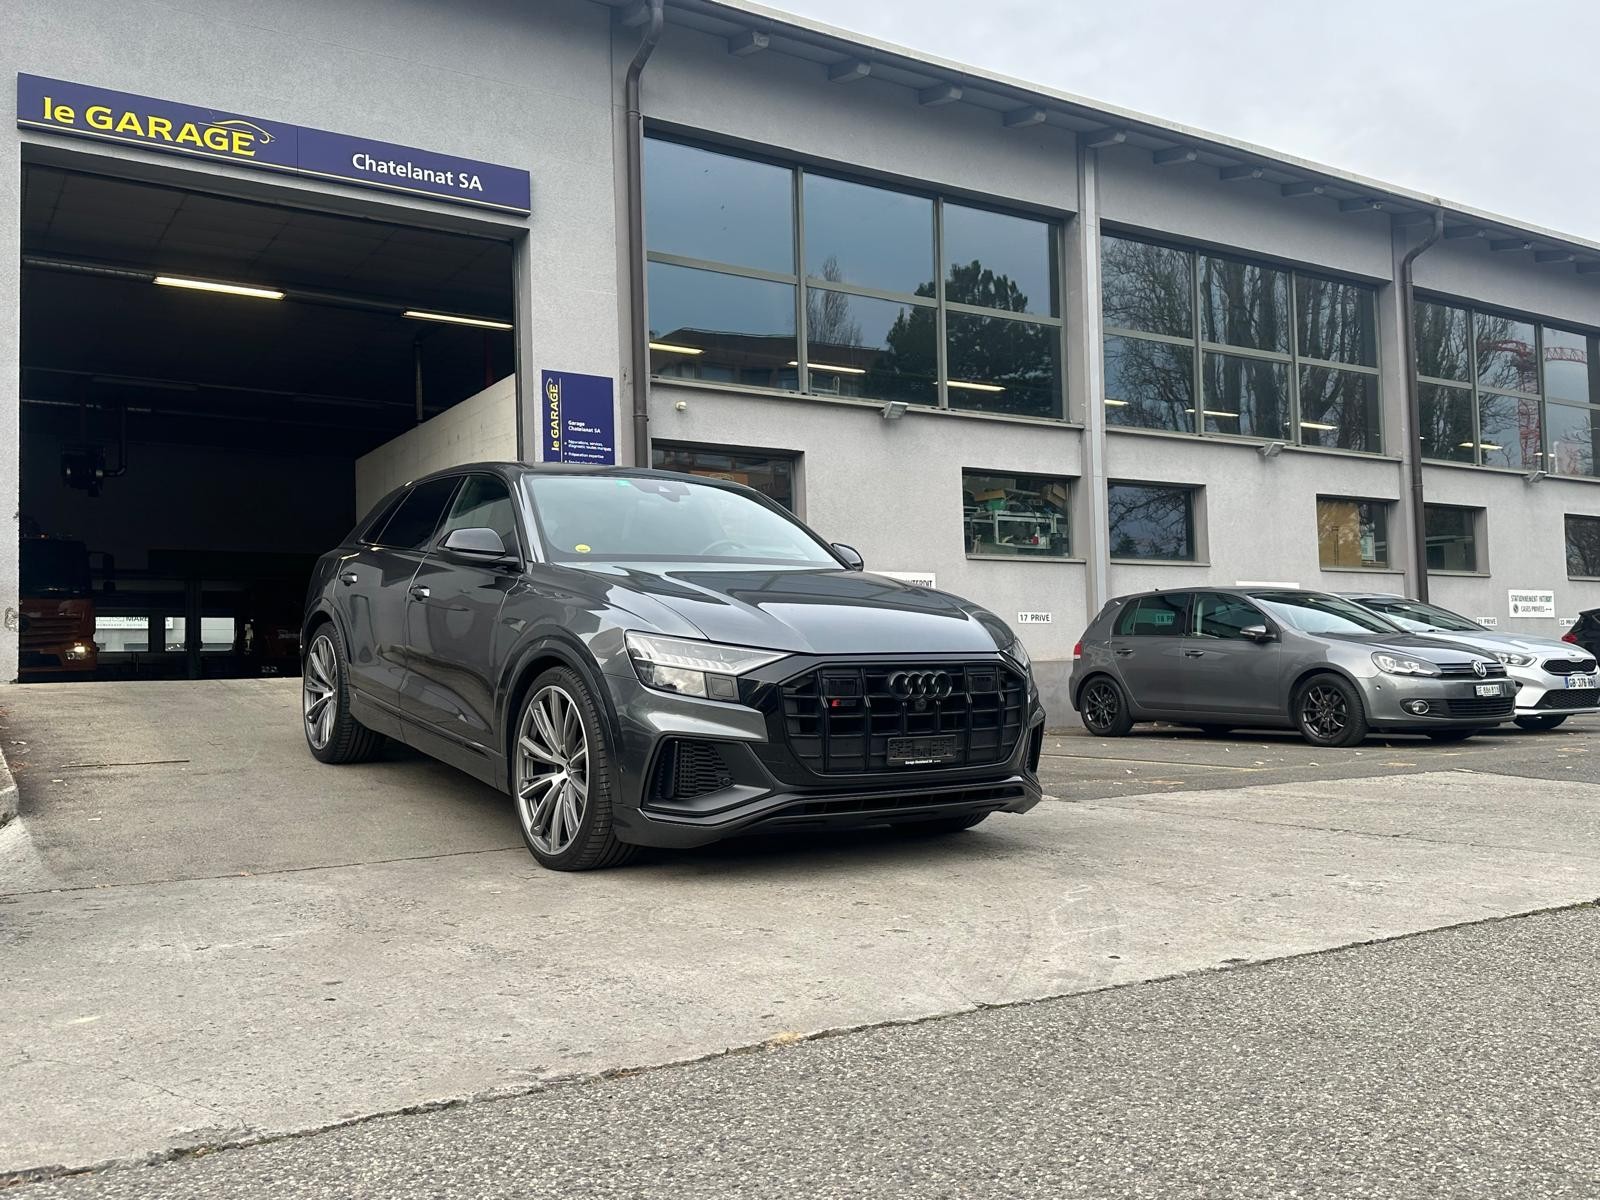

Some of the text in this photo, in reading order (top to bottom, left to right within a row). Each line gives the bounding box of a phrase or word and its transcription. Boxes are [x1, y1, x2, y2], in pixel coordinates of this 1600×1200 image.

[43, 96, 256, 157] le GARAGE
[352, 153, 483, 192] Chatelanat SA
[550, 384, 560, 451] le GARAGE
[1020, 614, 1050, 622] 17 PRIVE
